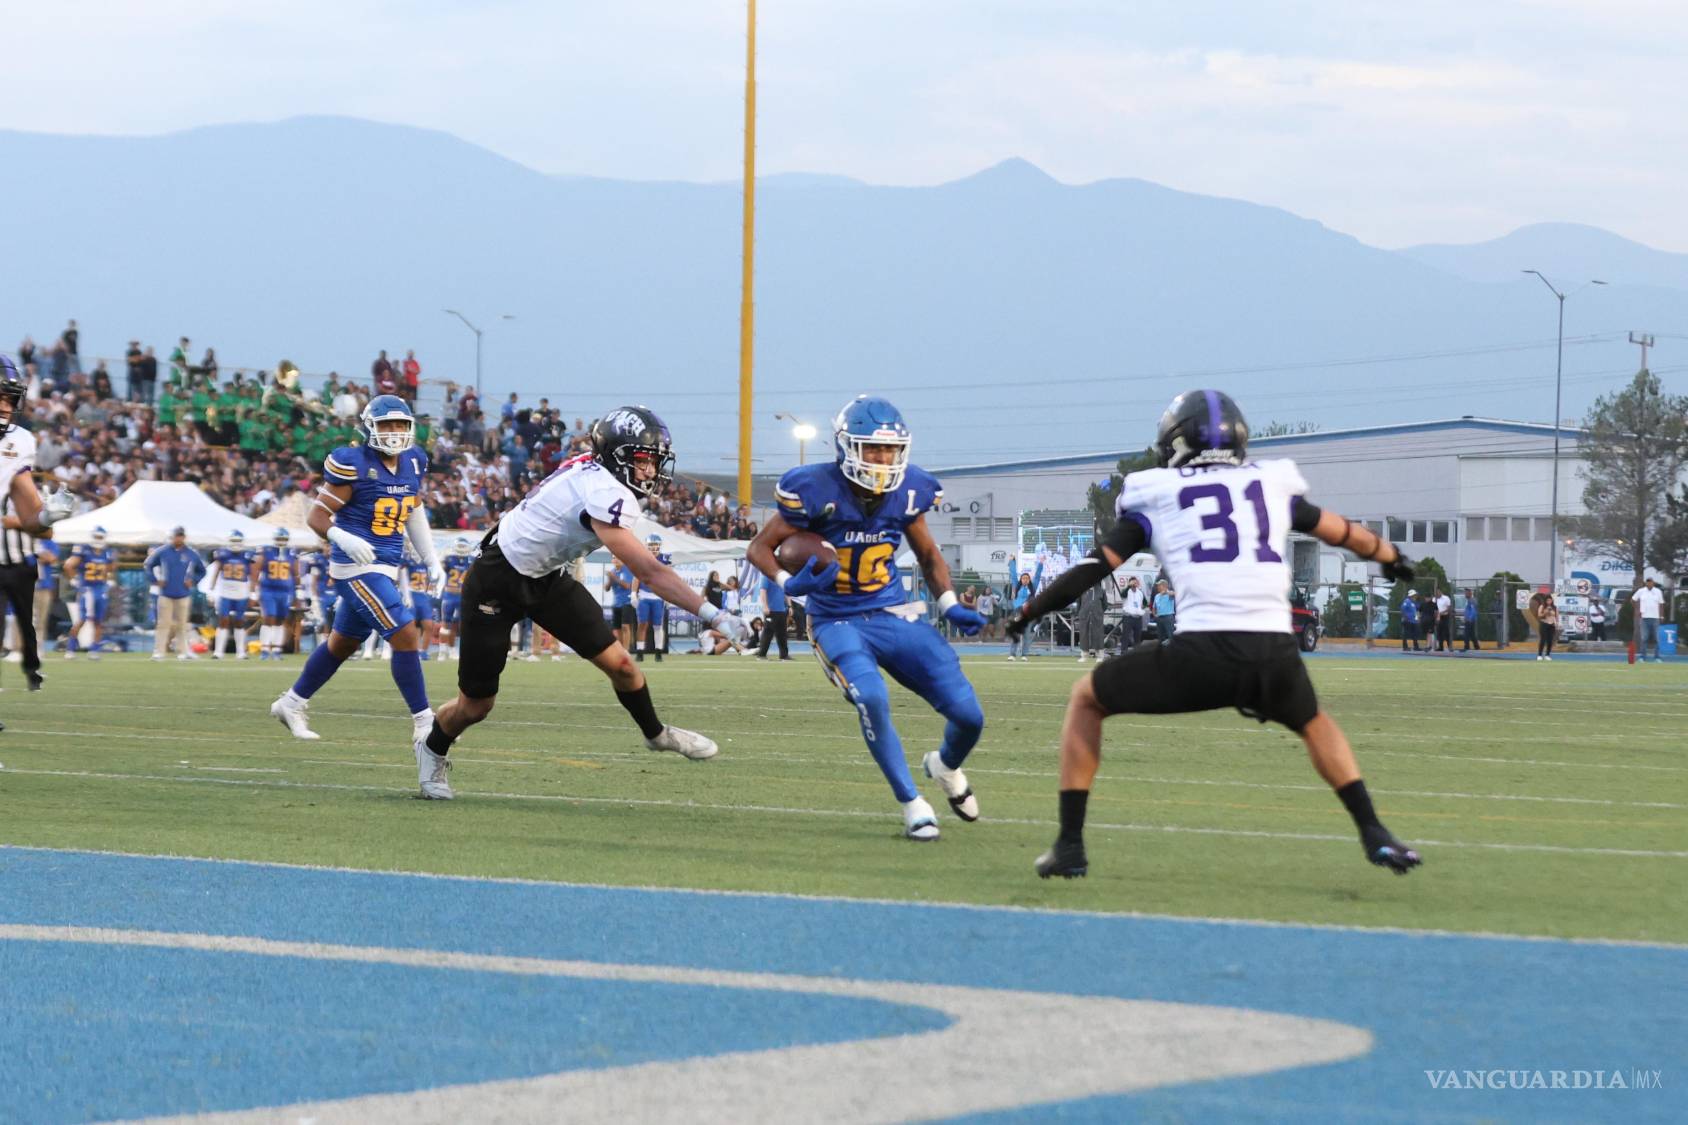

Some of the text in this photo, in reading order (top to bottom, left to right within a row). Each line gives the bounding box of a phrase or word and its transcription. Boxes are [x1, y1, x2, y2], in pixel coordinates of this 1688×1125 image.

[607, 498, 624, 528] 4
[905, 489, 920, 516] L
[1177, 479, 1283, 563] 31
[268, 561, 290, 580] 96
